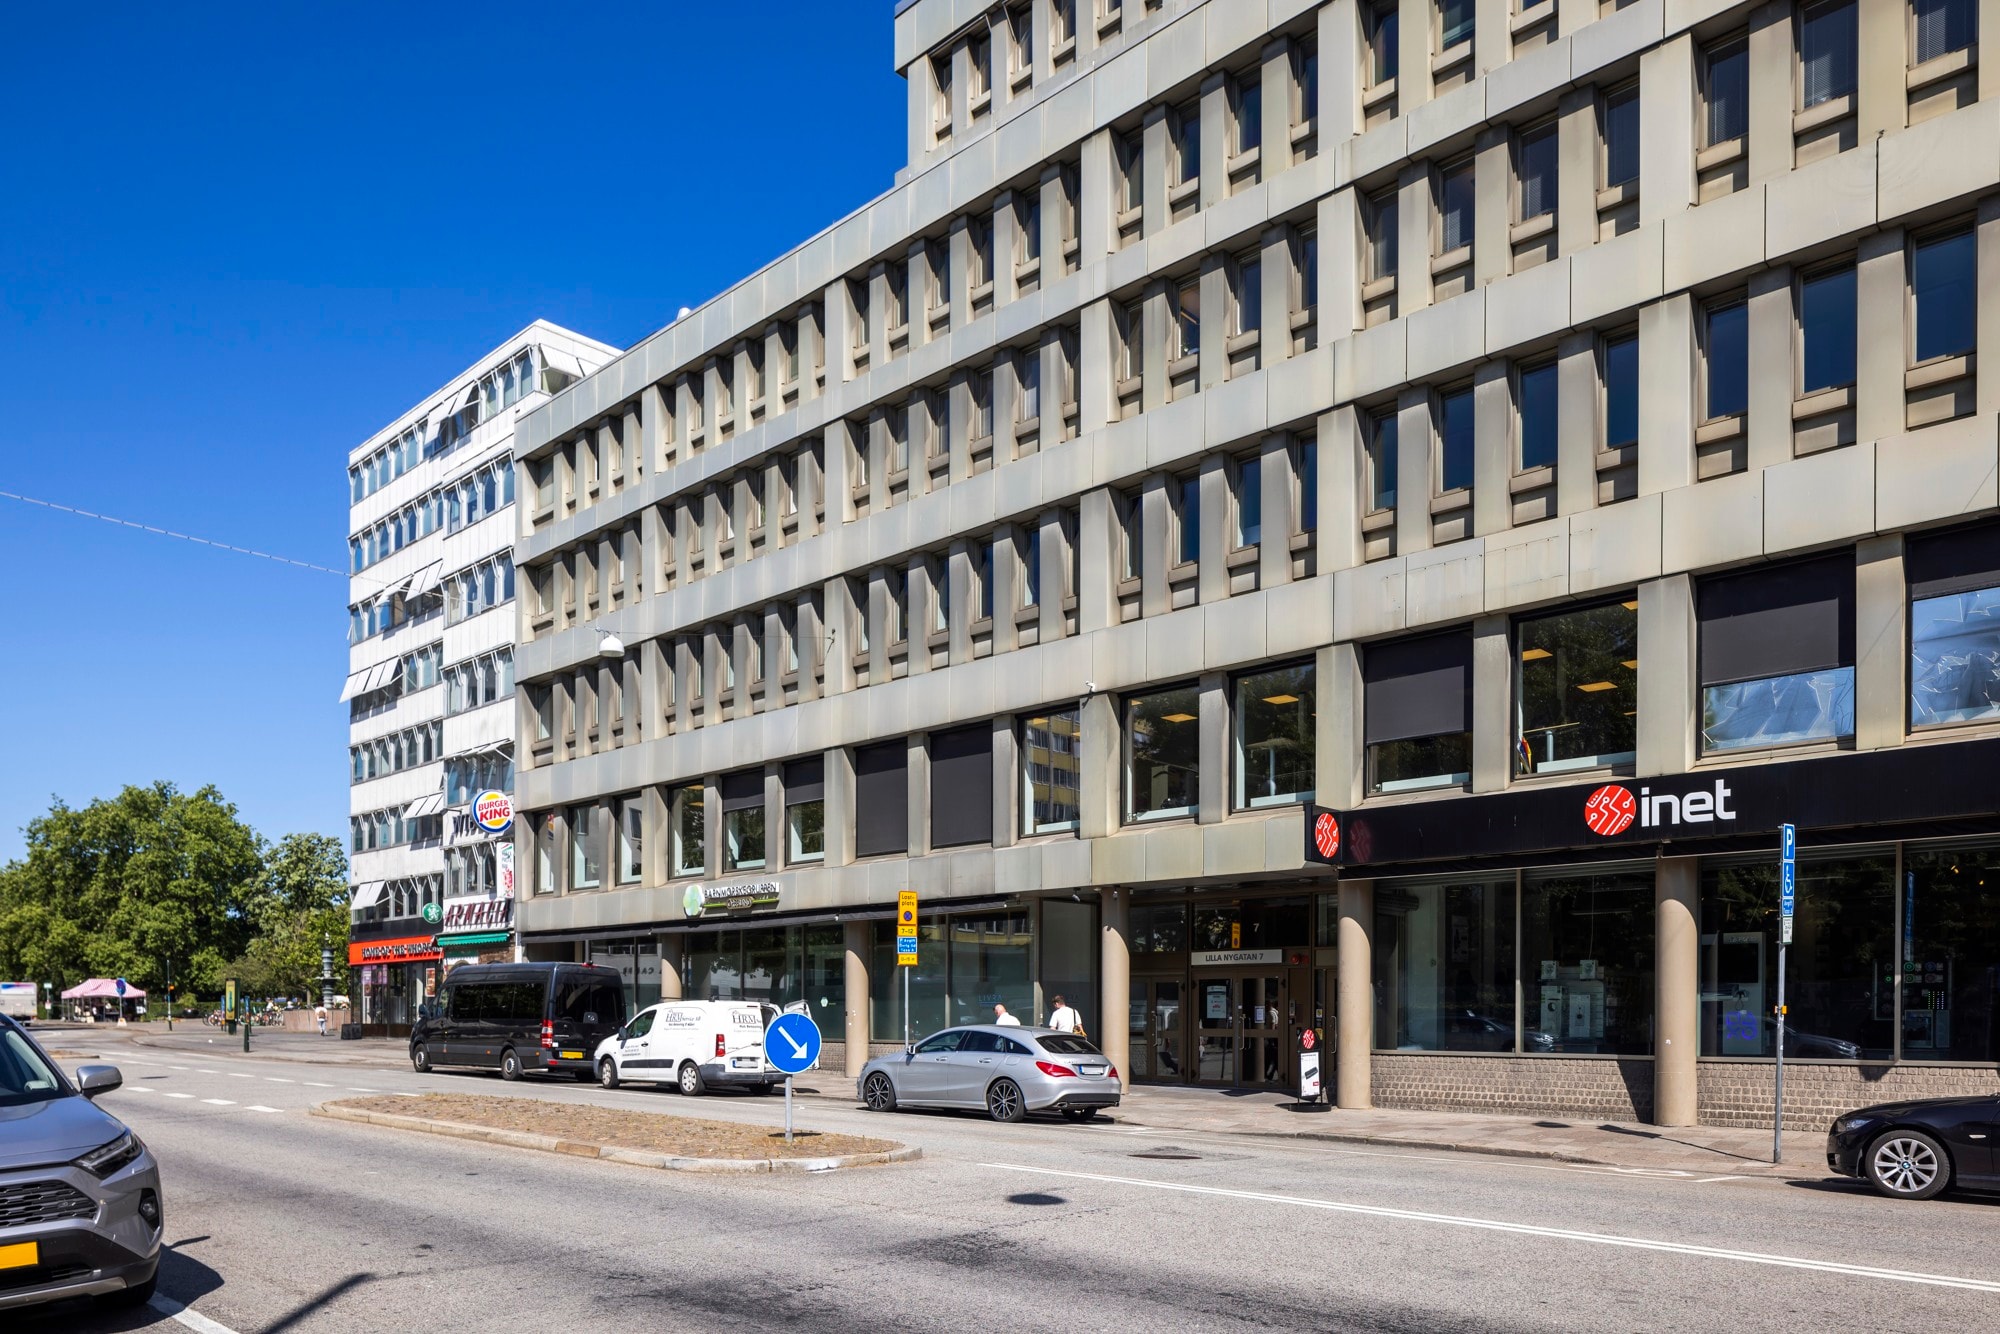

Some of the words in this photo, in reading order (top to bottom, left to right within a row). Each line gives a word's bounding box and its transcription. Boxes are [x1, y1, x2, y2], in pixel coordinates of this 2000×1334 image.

[478, 800, 509, 811] BURGER
[1641, 779, 1736, 827] inet
[479, 807, 510, 822] KING
[1786, 829, 1793, 857] P
[1253, 923, 1259, 932] 7
[1223, 953, 1257, 961] NYGATAN
[732, 1014, 756, 1024] HRM
